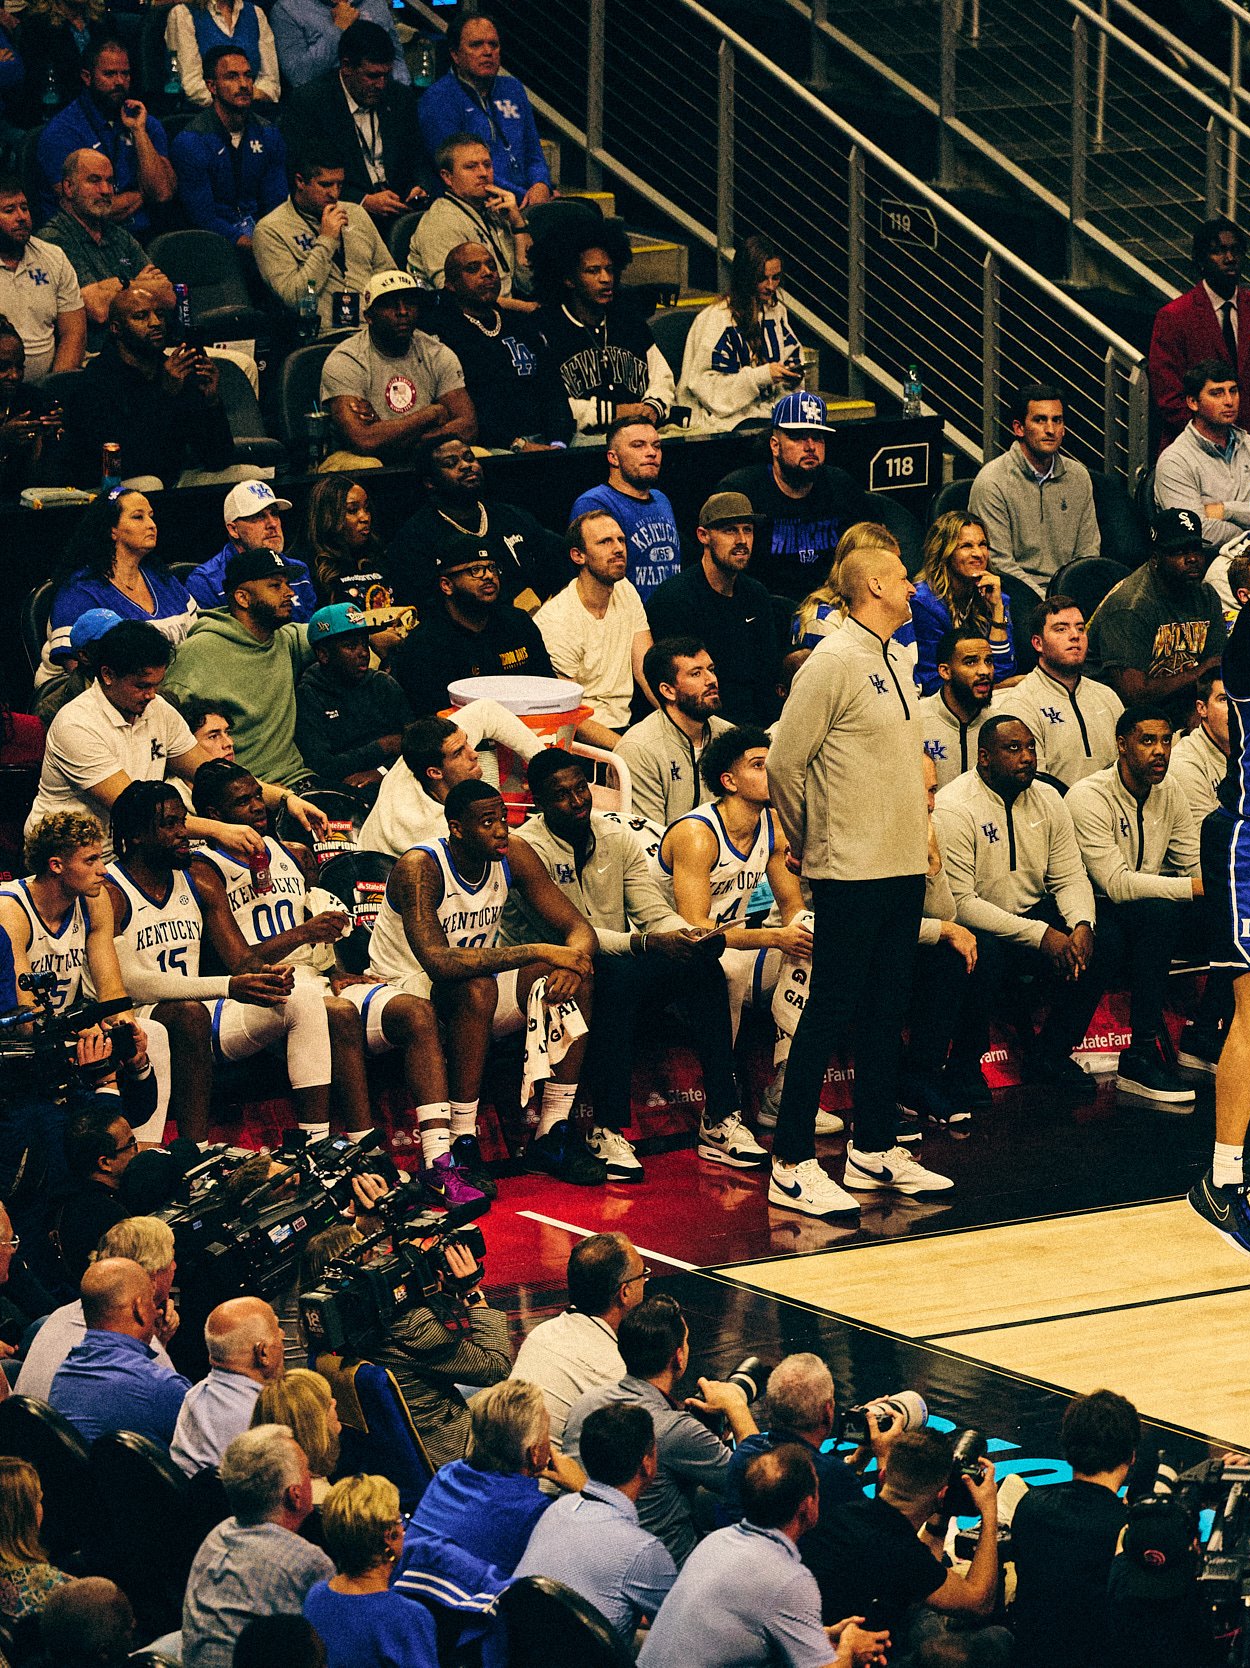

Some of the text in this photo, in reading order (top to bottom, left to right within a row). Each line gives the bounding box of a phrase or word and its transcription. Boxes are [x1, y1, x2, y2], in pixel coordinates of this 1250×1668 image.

[381, 278, 394, 288] NEW
[559, 347, 601, 400] NEW
[886, 456, 915, 478] 118
[867, 673, 889, 695] UK
[1040, 706, 1065, 725] UK
[981, 822, 1000, 844] UK
[251, 898, 297, 944] 00
[136, 919, 201, 952] KENTUCKY
[155, 946, 189, 977] 15
